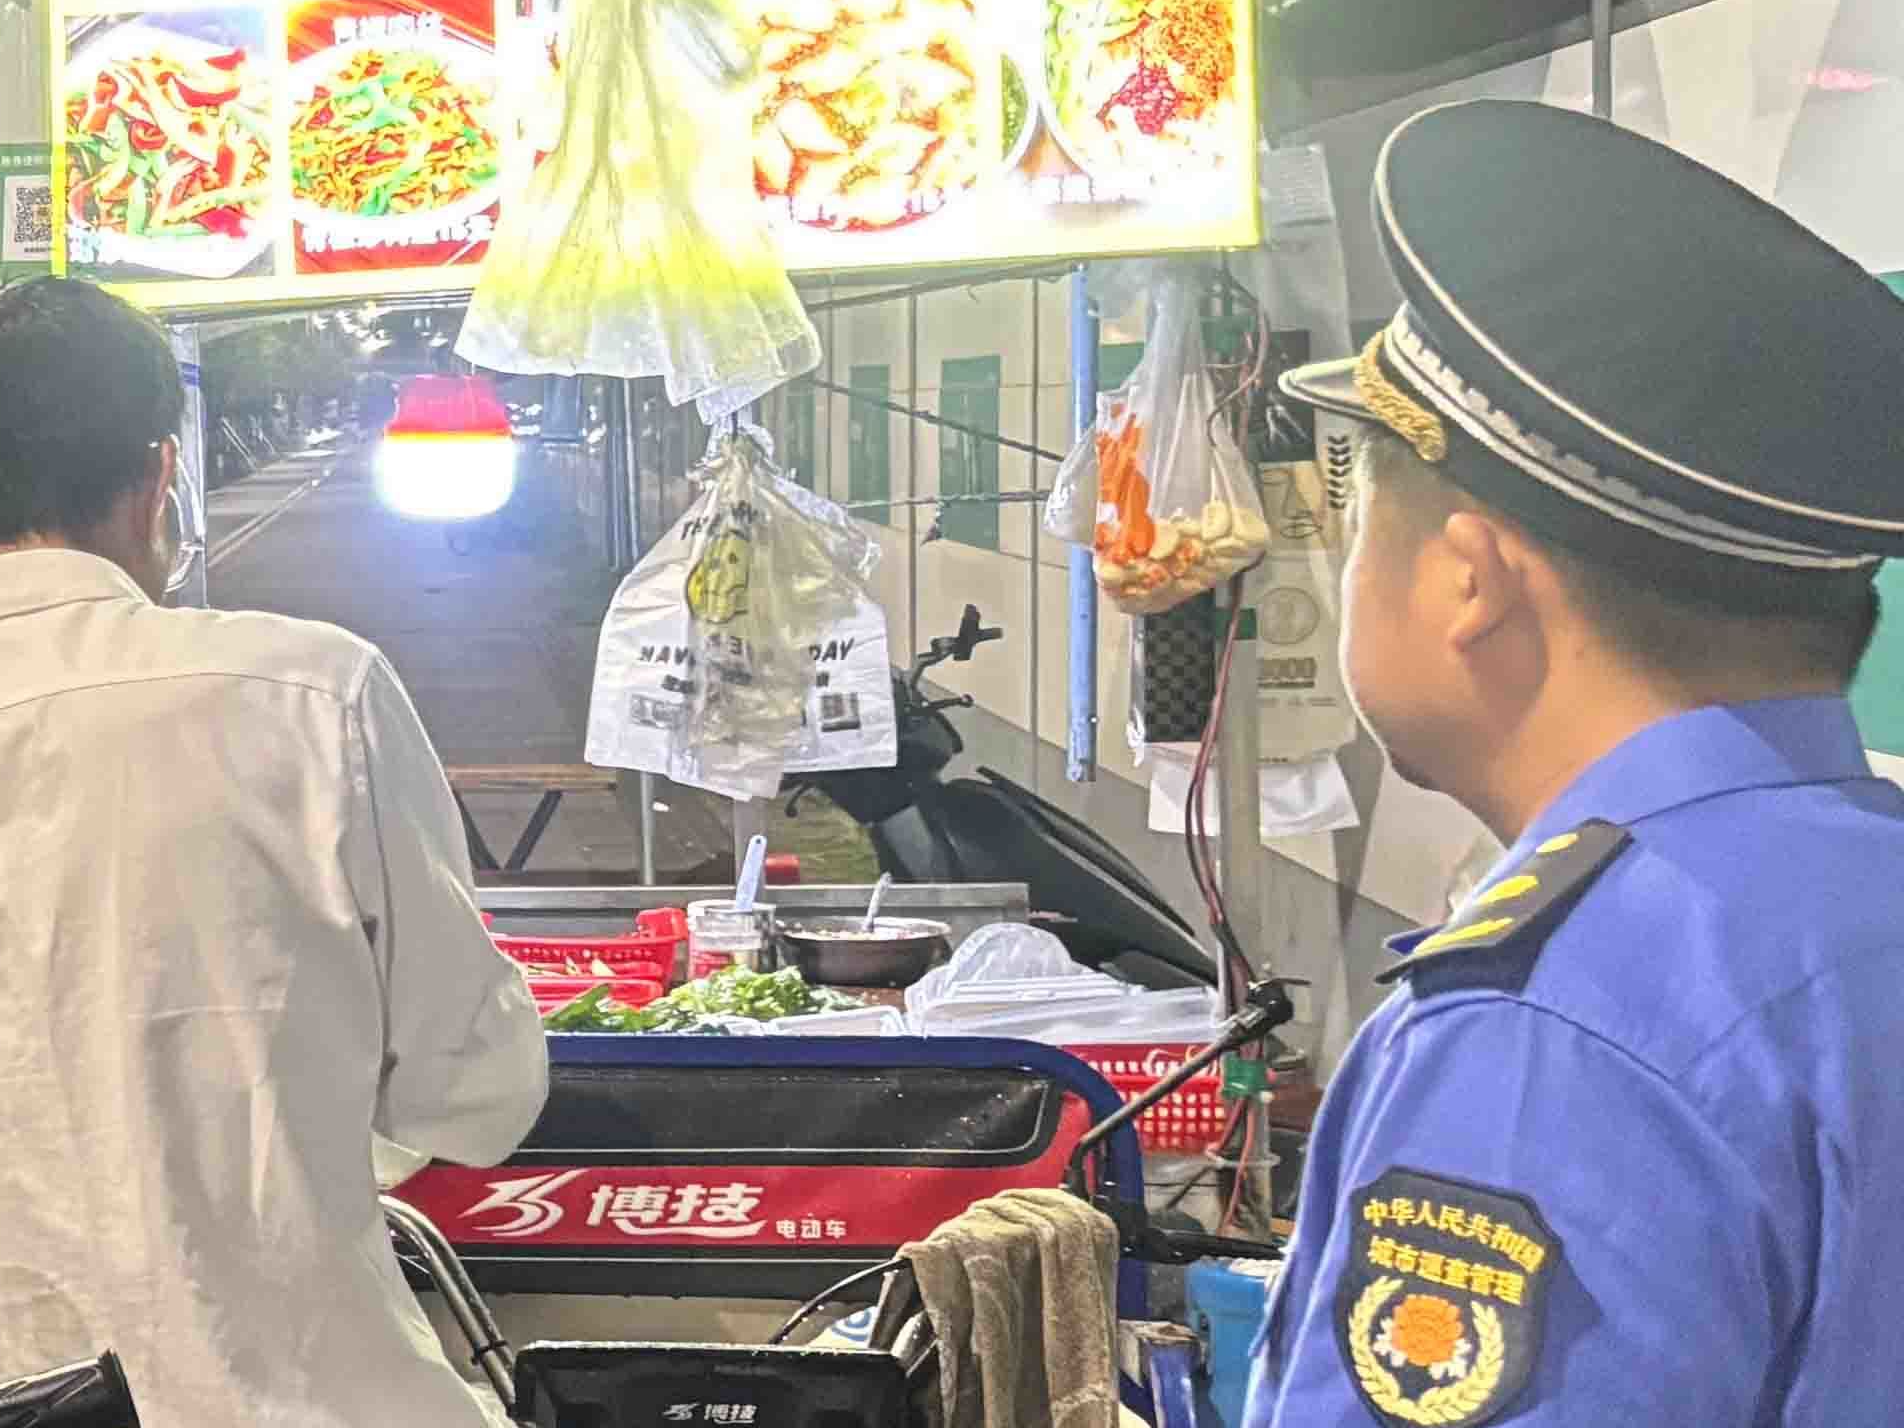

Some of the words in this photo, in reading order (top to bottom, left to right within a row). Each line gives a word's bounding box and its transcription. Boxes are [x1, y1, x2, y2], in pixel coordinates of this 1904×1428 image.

[590, 1183, 766, 1237] 博技
[776, 1219, 847, 1240] 电动车
